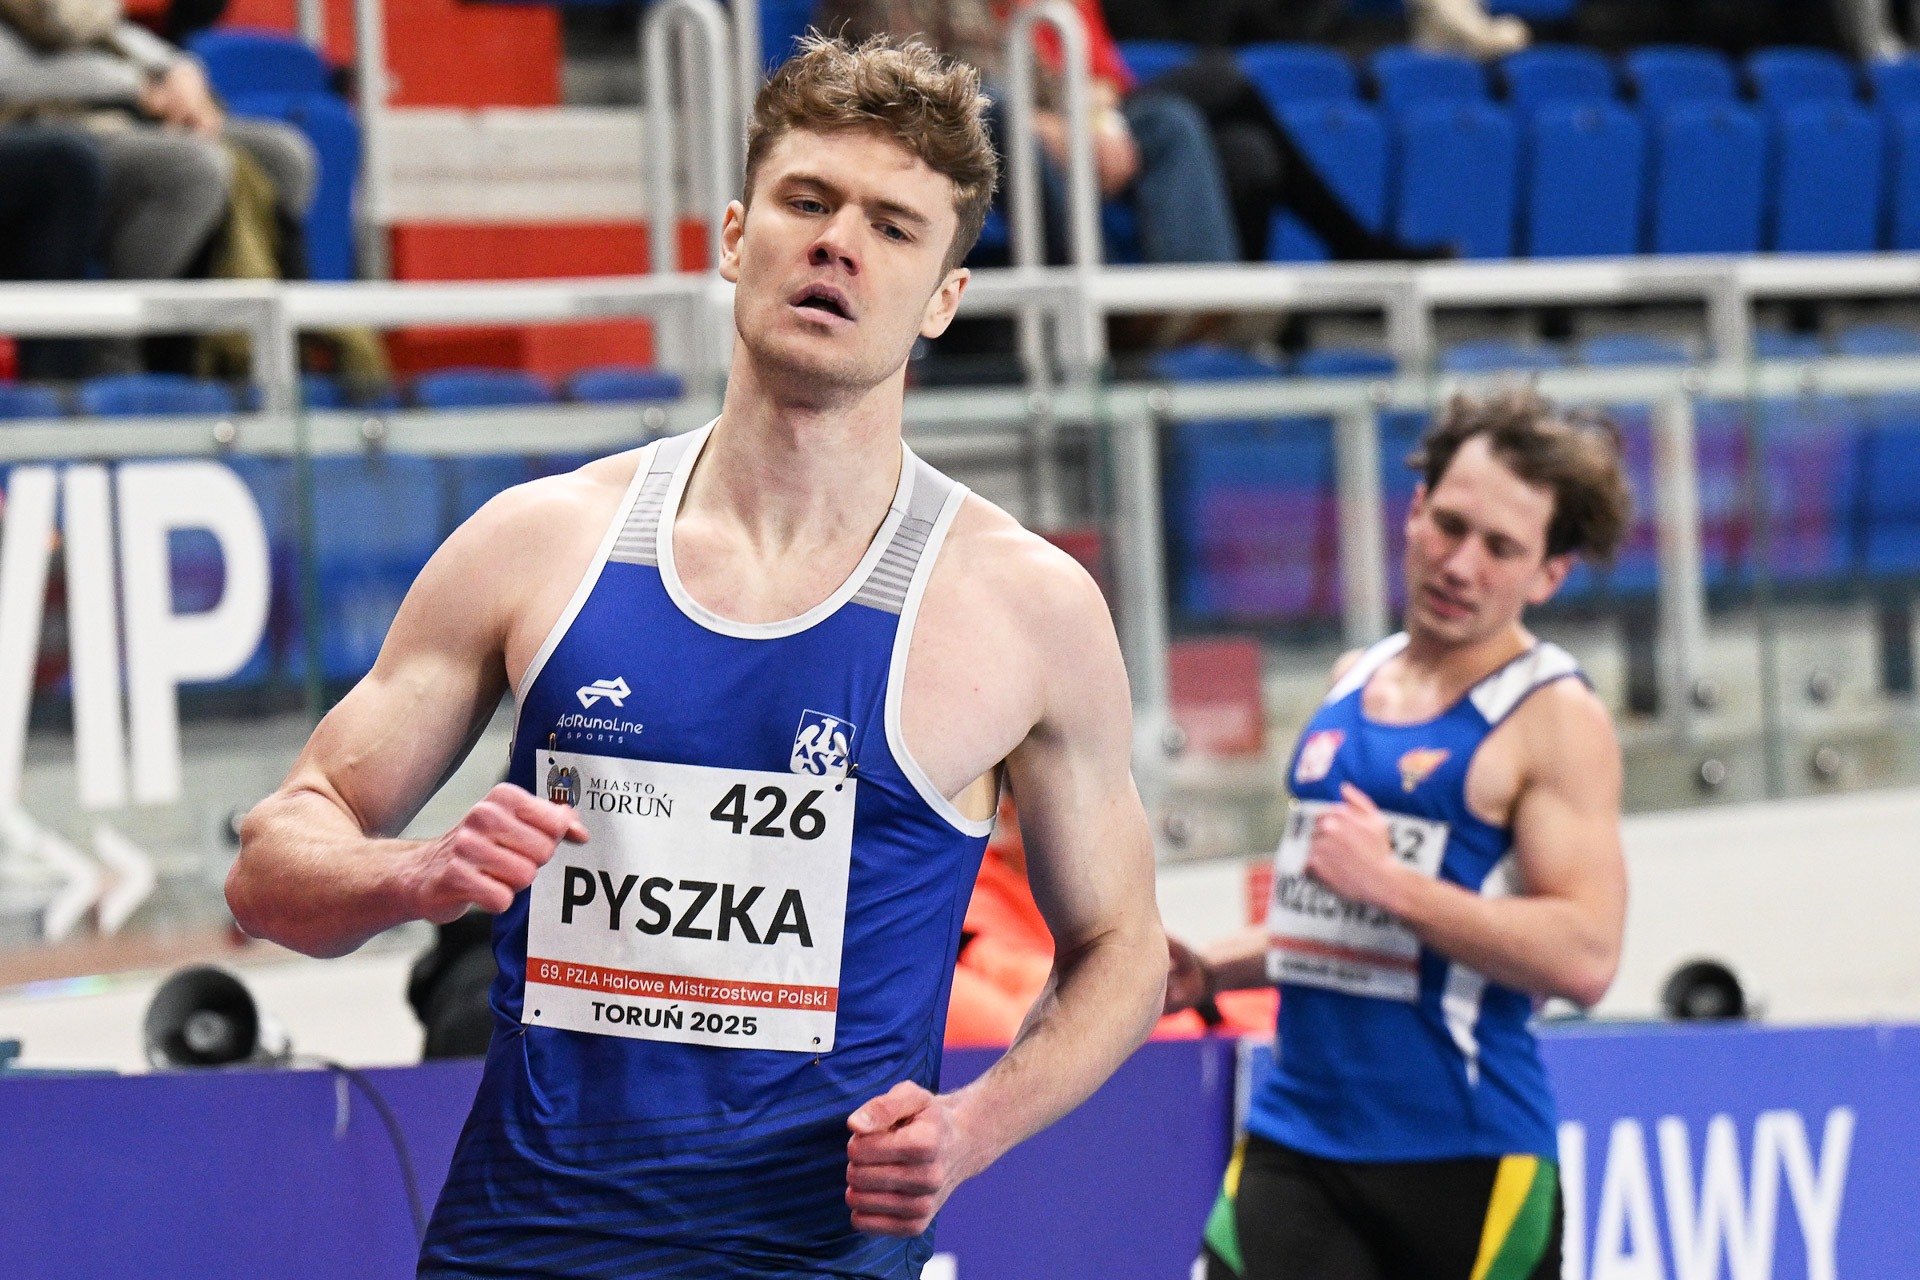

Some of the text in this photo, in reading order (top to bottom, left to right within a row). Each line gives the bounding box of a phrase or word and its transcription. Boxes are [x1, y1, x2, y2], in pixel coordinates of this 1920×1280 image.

[567, 732, 623, 744] SPORTS
[590, 777, 655, 795] MIASTO
[586, 790, 674, 819] TORUŃ
[710, 783, 826, 840] 426
[561, 866, 814, 948] PYSZKA
[540, 963, 828, 1006] 69. PZLA Halowe Mistrzostwa Polski
[591, 1002, 758, 1036] TORUŃ 2025
